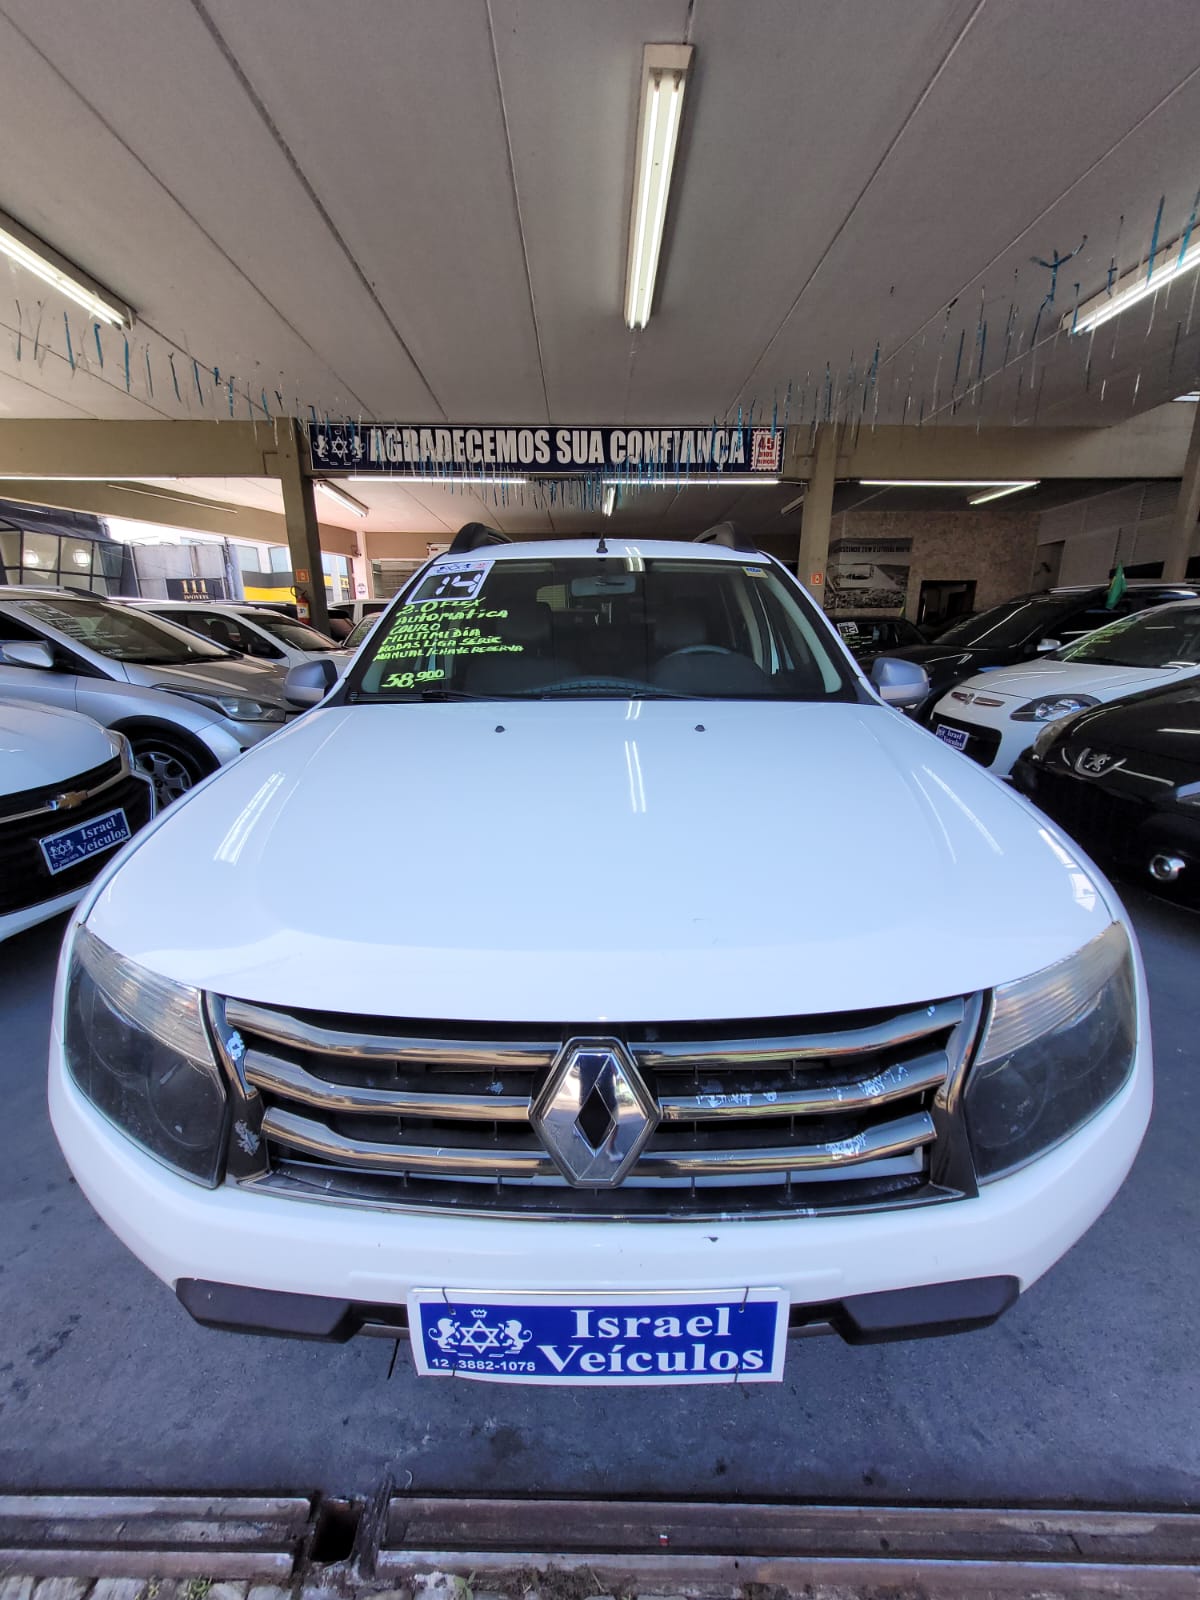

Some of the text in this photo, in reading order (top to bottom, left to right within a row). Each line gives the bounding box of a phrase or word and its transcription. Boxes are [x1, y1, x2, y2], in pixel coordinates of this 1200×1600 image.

[370, 428, 745, 471] AGRADECEMOS SUA CONFIANÇA
[435, 573, 482, 596] 14
[396, 597, 487, 616] 2.0 FLEX
[389, 623, 441, 636] COURO
[377, 641, 421, 654] RODAS
[423, 639, 457, 648] LIGA
[81, 816, 117, 840] Israel
[77, 826, 127, 855] Veículos
[570, 1307, 731, 1338] Israel
[431, 1358, 536, 1372] 12 3882-1078
[536, 1343, 764, 1373] Veículos
